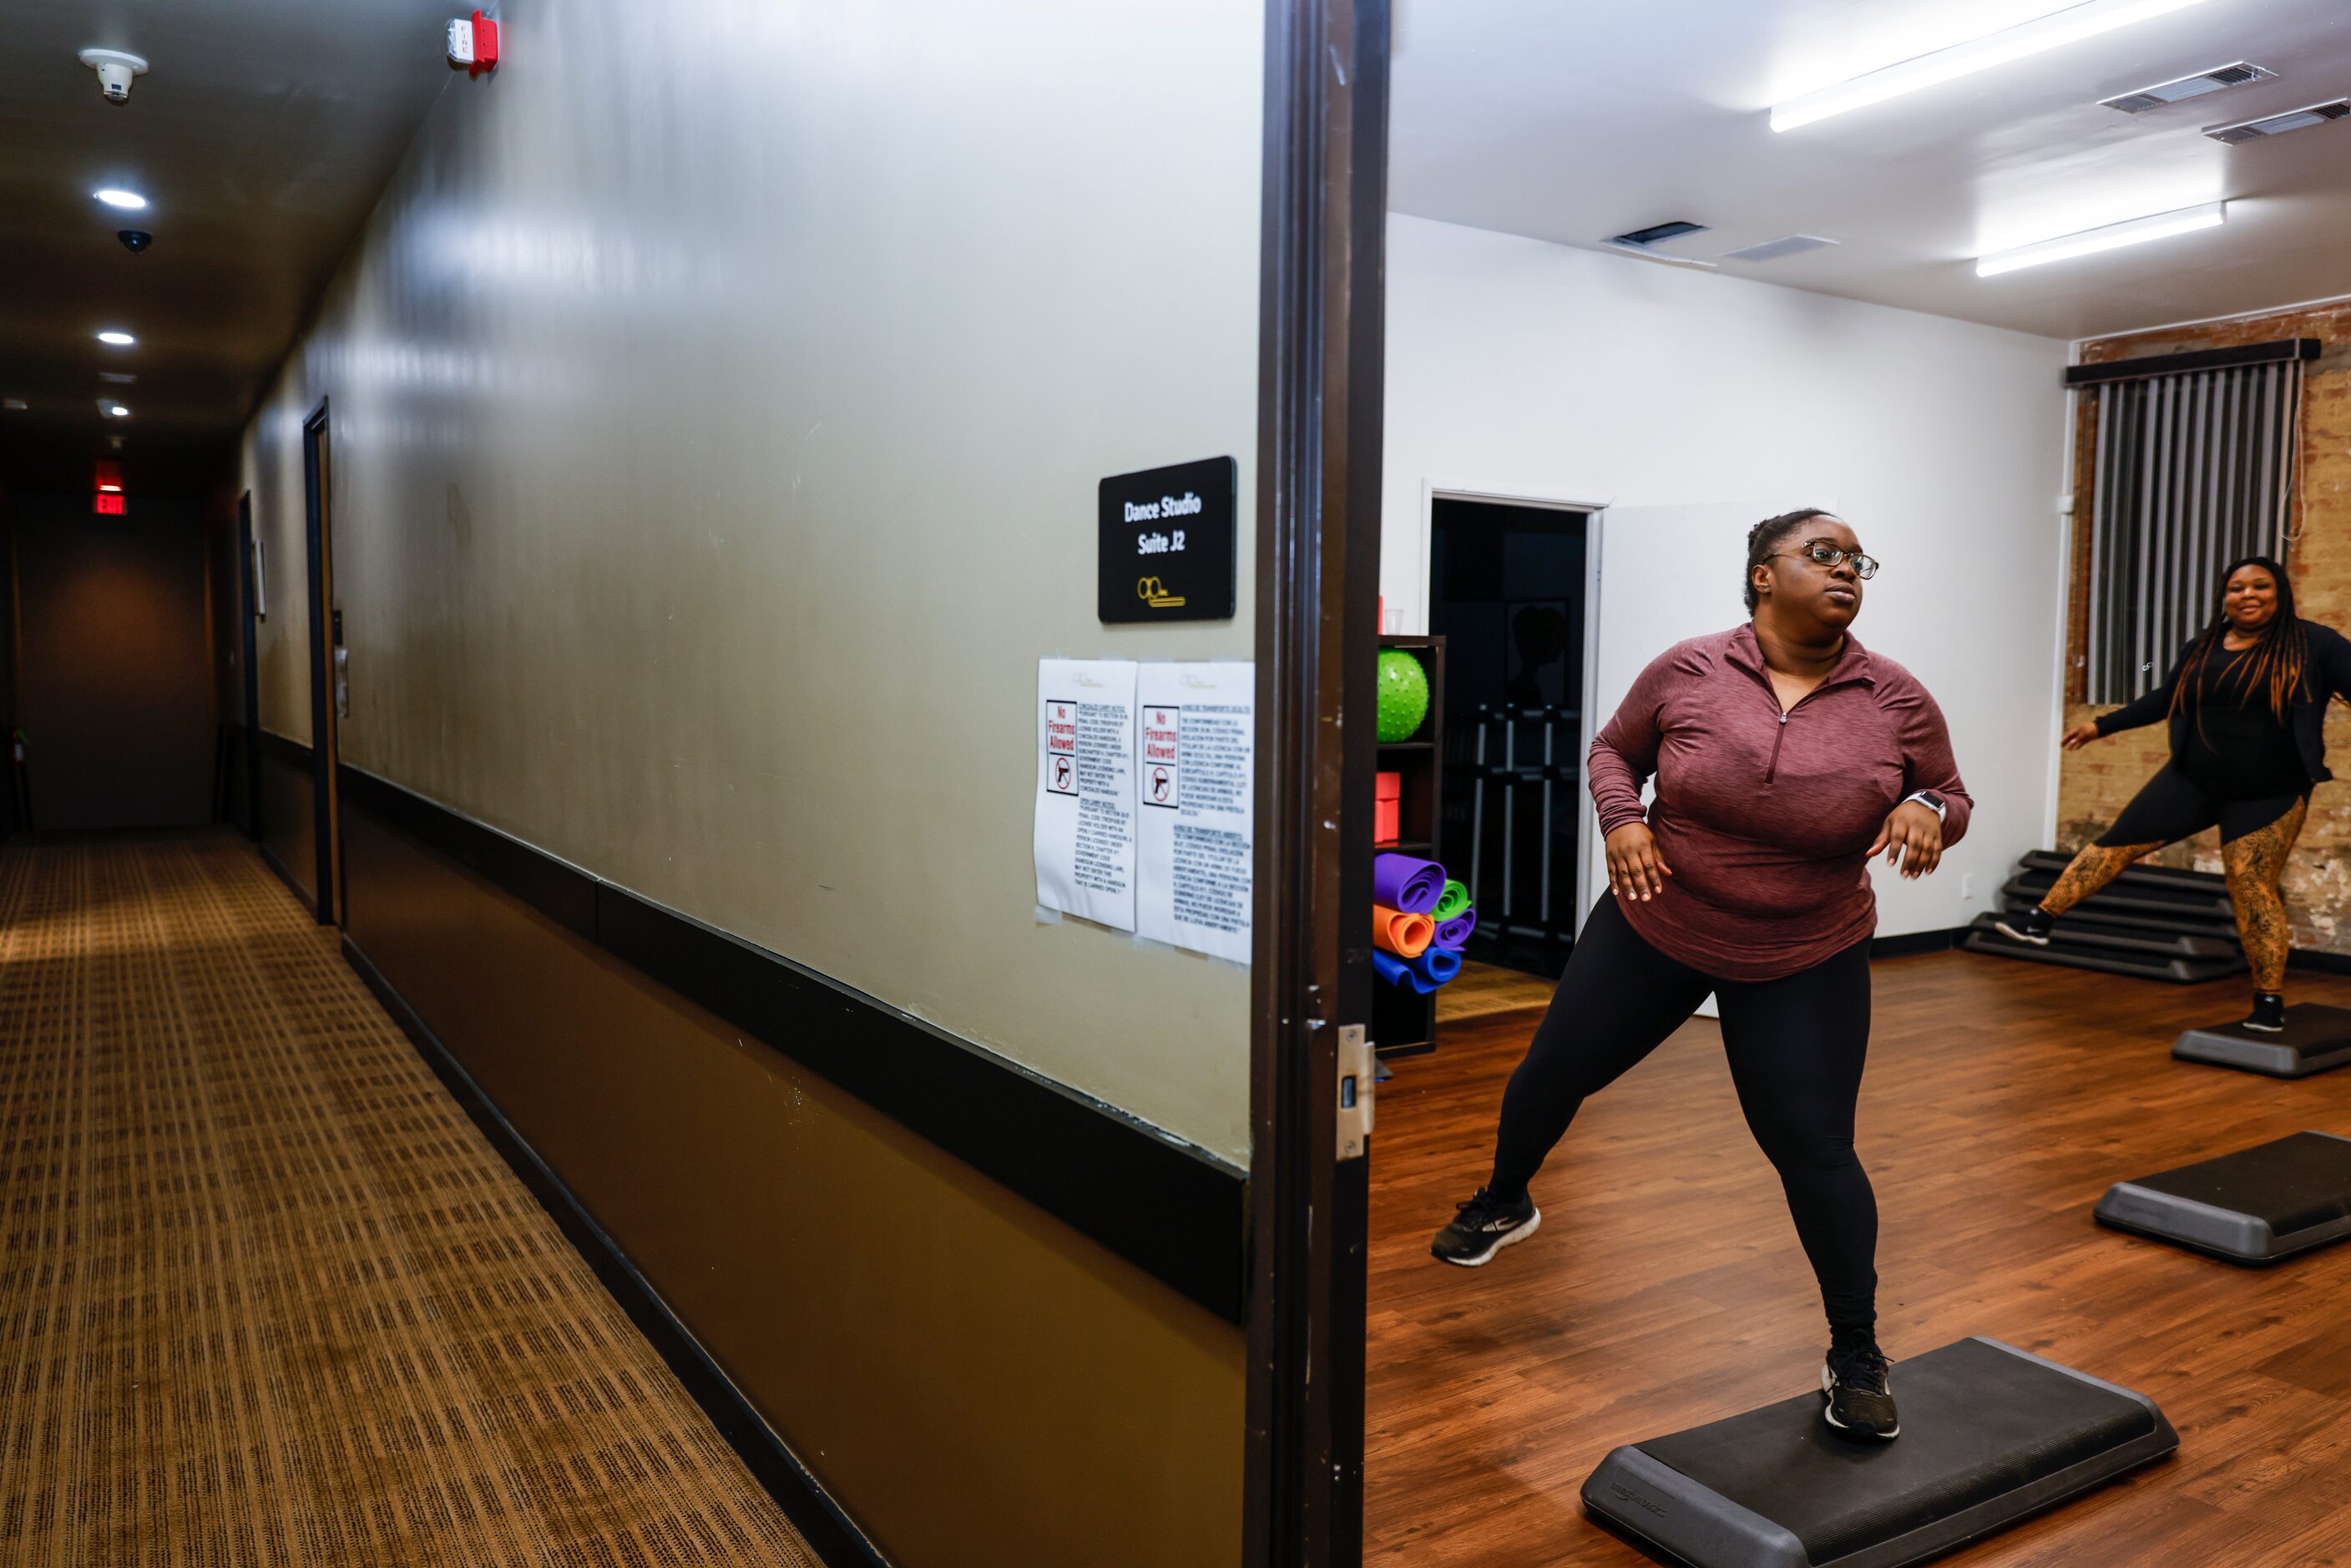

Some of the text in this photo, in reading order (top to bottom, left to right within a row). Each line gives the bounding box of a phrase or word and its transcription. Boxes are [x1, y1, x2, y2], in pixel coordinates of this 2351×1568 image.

[97, 494, 124, 514] EXIT
[1125, 492, 1201, 523] Dance Studio
[1137, 530, 1186, 554] Suite J2
[1057, 706, 1066, 719] No
[1155, 711, 1166, 725] No
[1049, 720, 1075, 735] Firearms
[1145, 727, 1176, 742] Firearms
[1049, 736, 1074, 751] Allowed
[1147, 743, 1176, 760] Allowed
